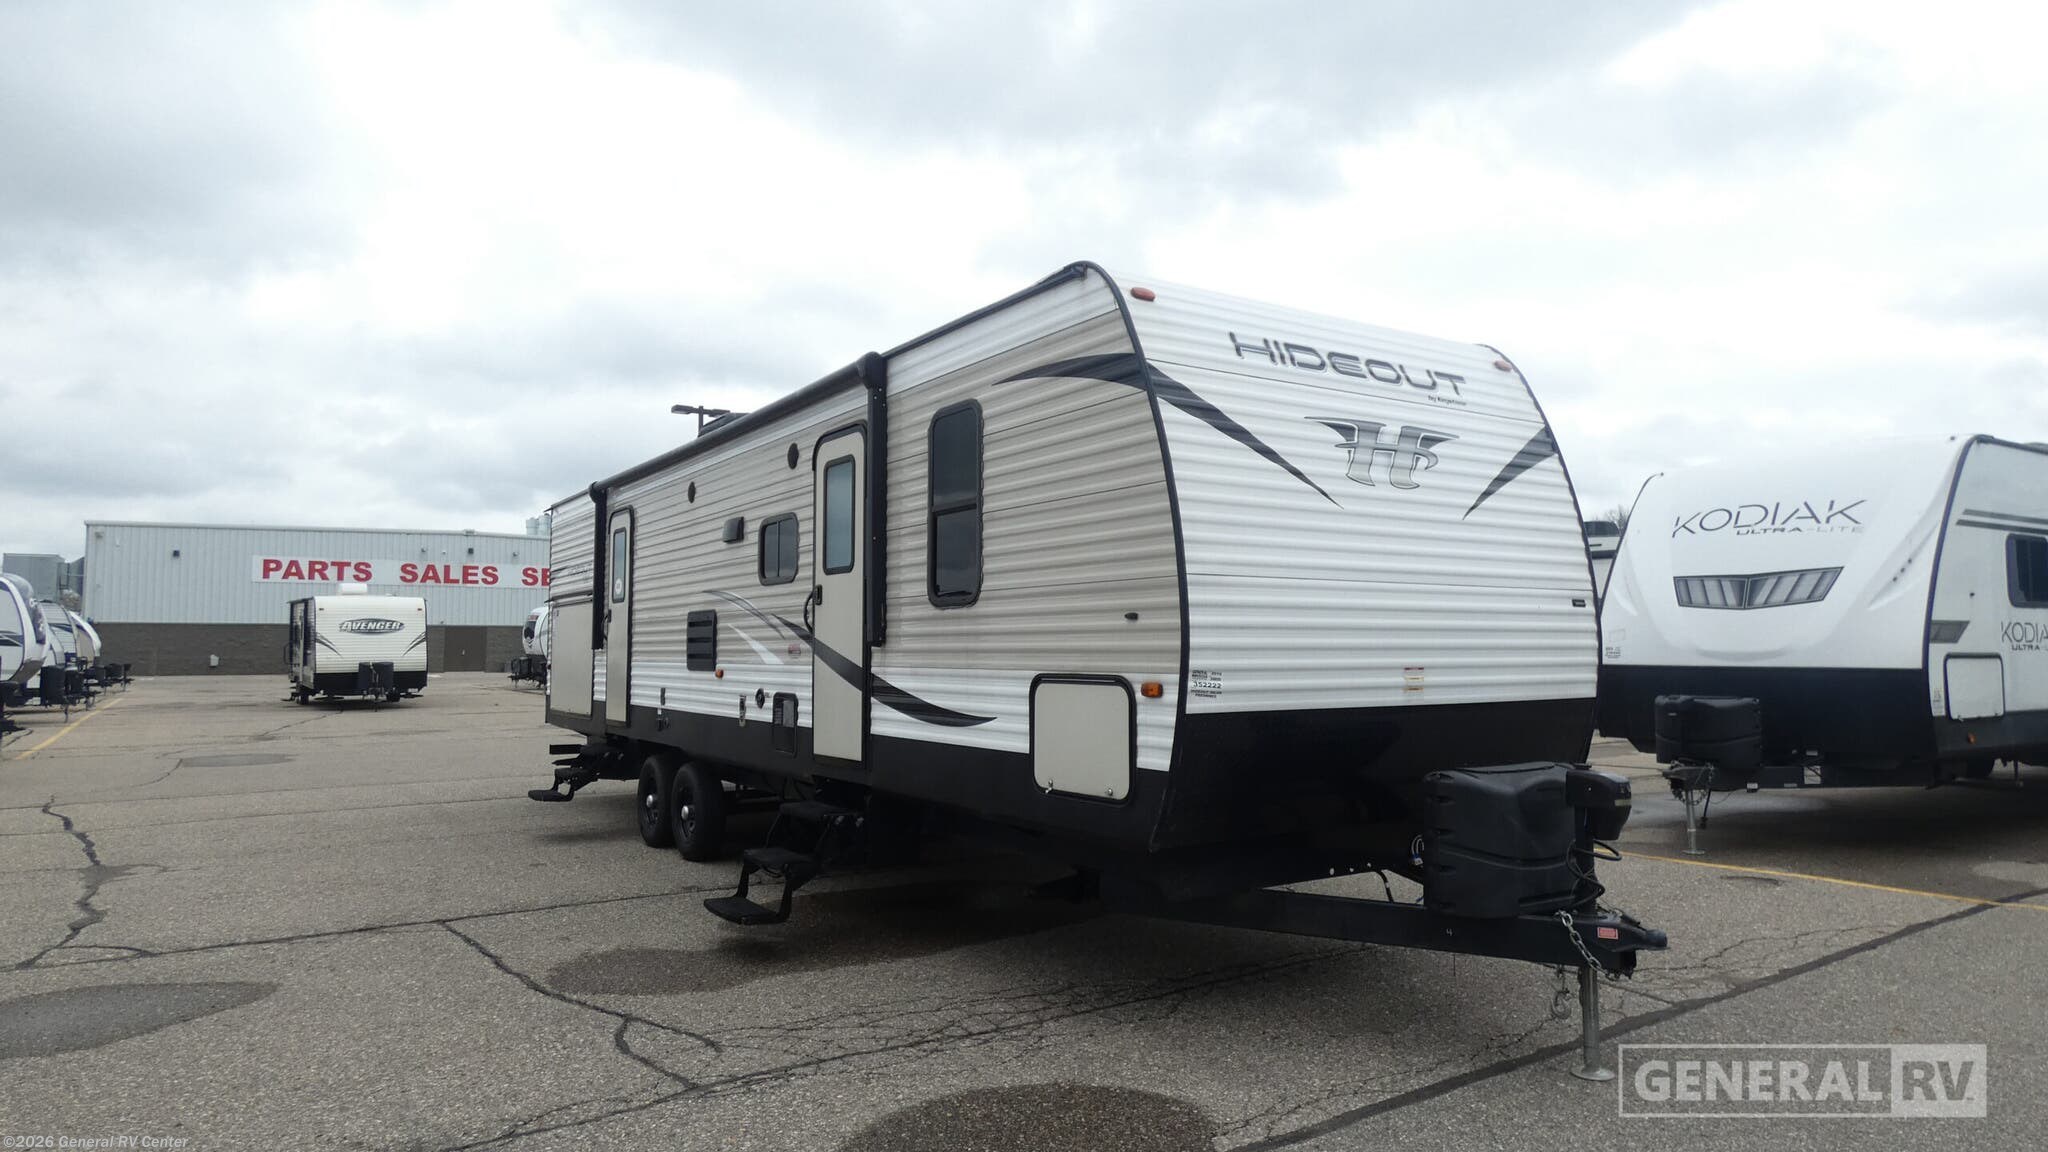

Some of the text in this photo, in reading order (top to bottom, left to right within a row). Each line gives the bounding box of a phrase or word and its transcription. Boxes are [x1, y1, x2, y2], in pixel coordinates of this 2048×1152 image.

[1229, 331, 1466, 395] HIDEOUT
[1672, 499, 1866, 538] KODIAK
[262, 558, 373, 582] PARTS
[400, 563, 499, 586] SALES
[340, 620, 401, 631] AVENGER
